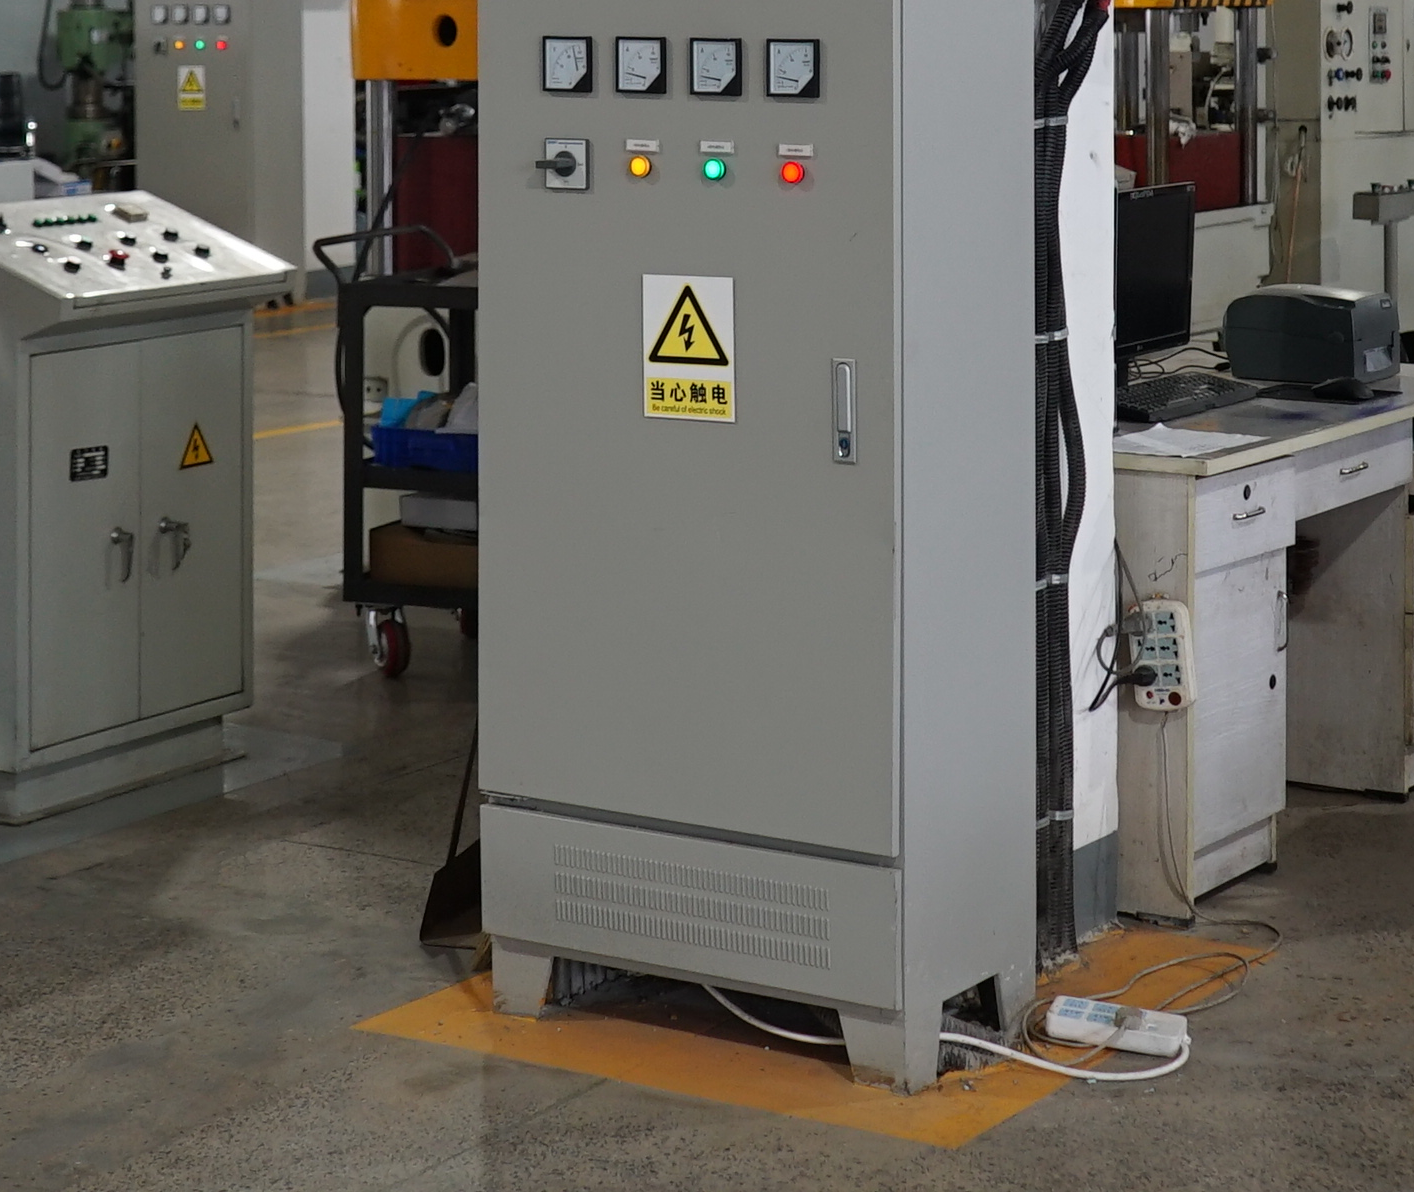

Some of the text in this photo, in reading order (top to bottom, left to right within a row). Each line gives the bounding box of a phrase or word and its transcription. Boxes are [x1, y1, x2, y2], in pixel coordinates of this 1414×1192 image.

[651, 380, 728, 405] 当心触电
[688, 406, 708, 415] electric
[709, 408, 726, 416] shock
